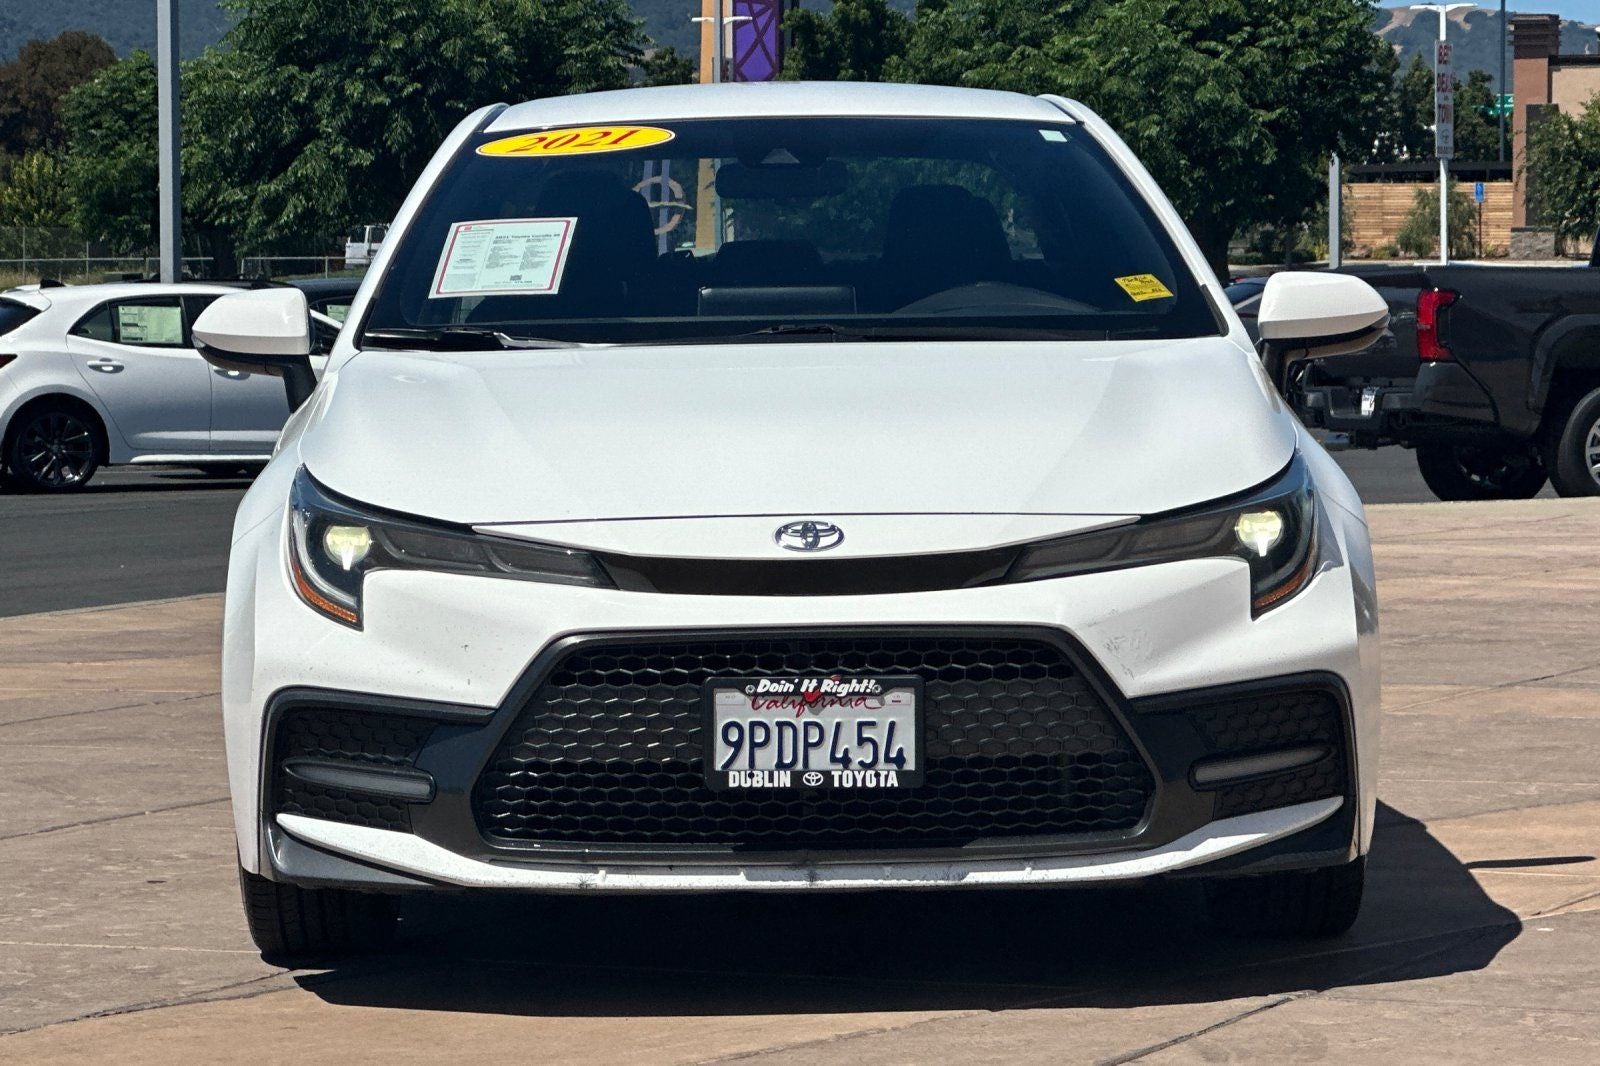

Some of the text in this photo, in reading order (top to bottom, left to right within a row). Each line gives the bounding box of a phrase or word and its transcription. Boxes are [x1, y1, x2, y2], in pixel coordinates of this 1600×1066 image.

[507, 130, 640, 153] 2021
[757, 678, 876, 697] Doin' It Right!
[720, 720, 907, 769] 9PDP454
[728, 770, 899, 787] DUBLIN TOYOTA
